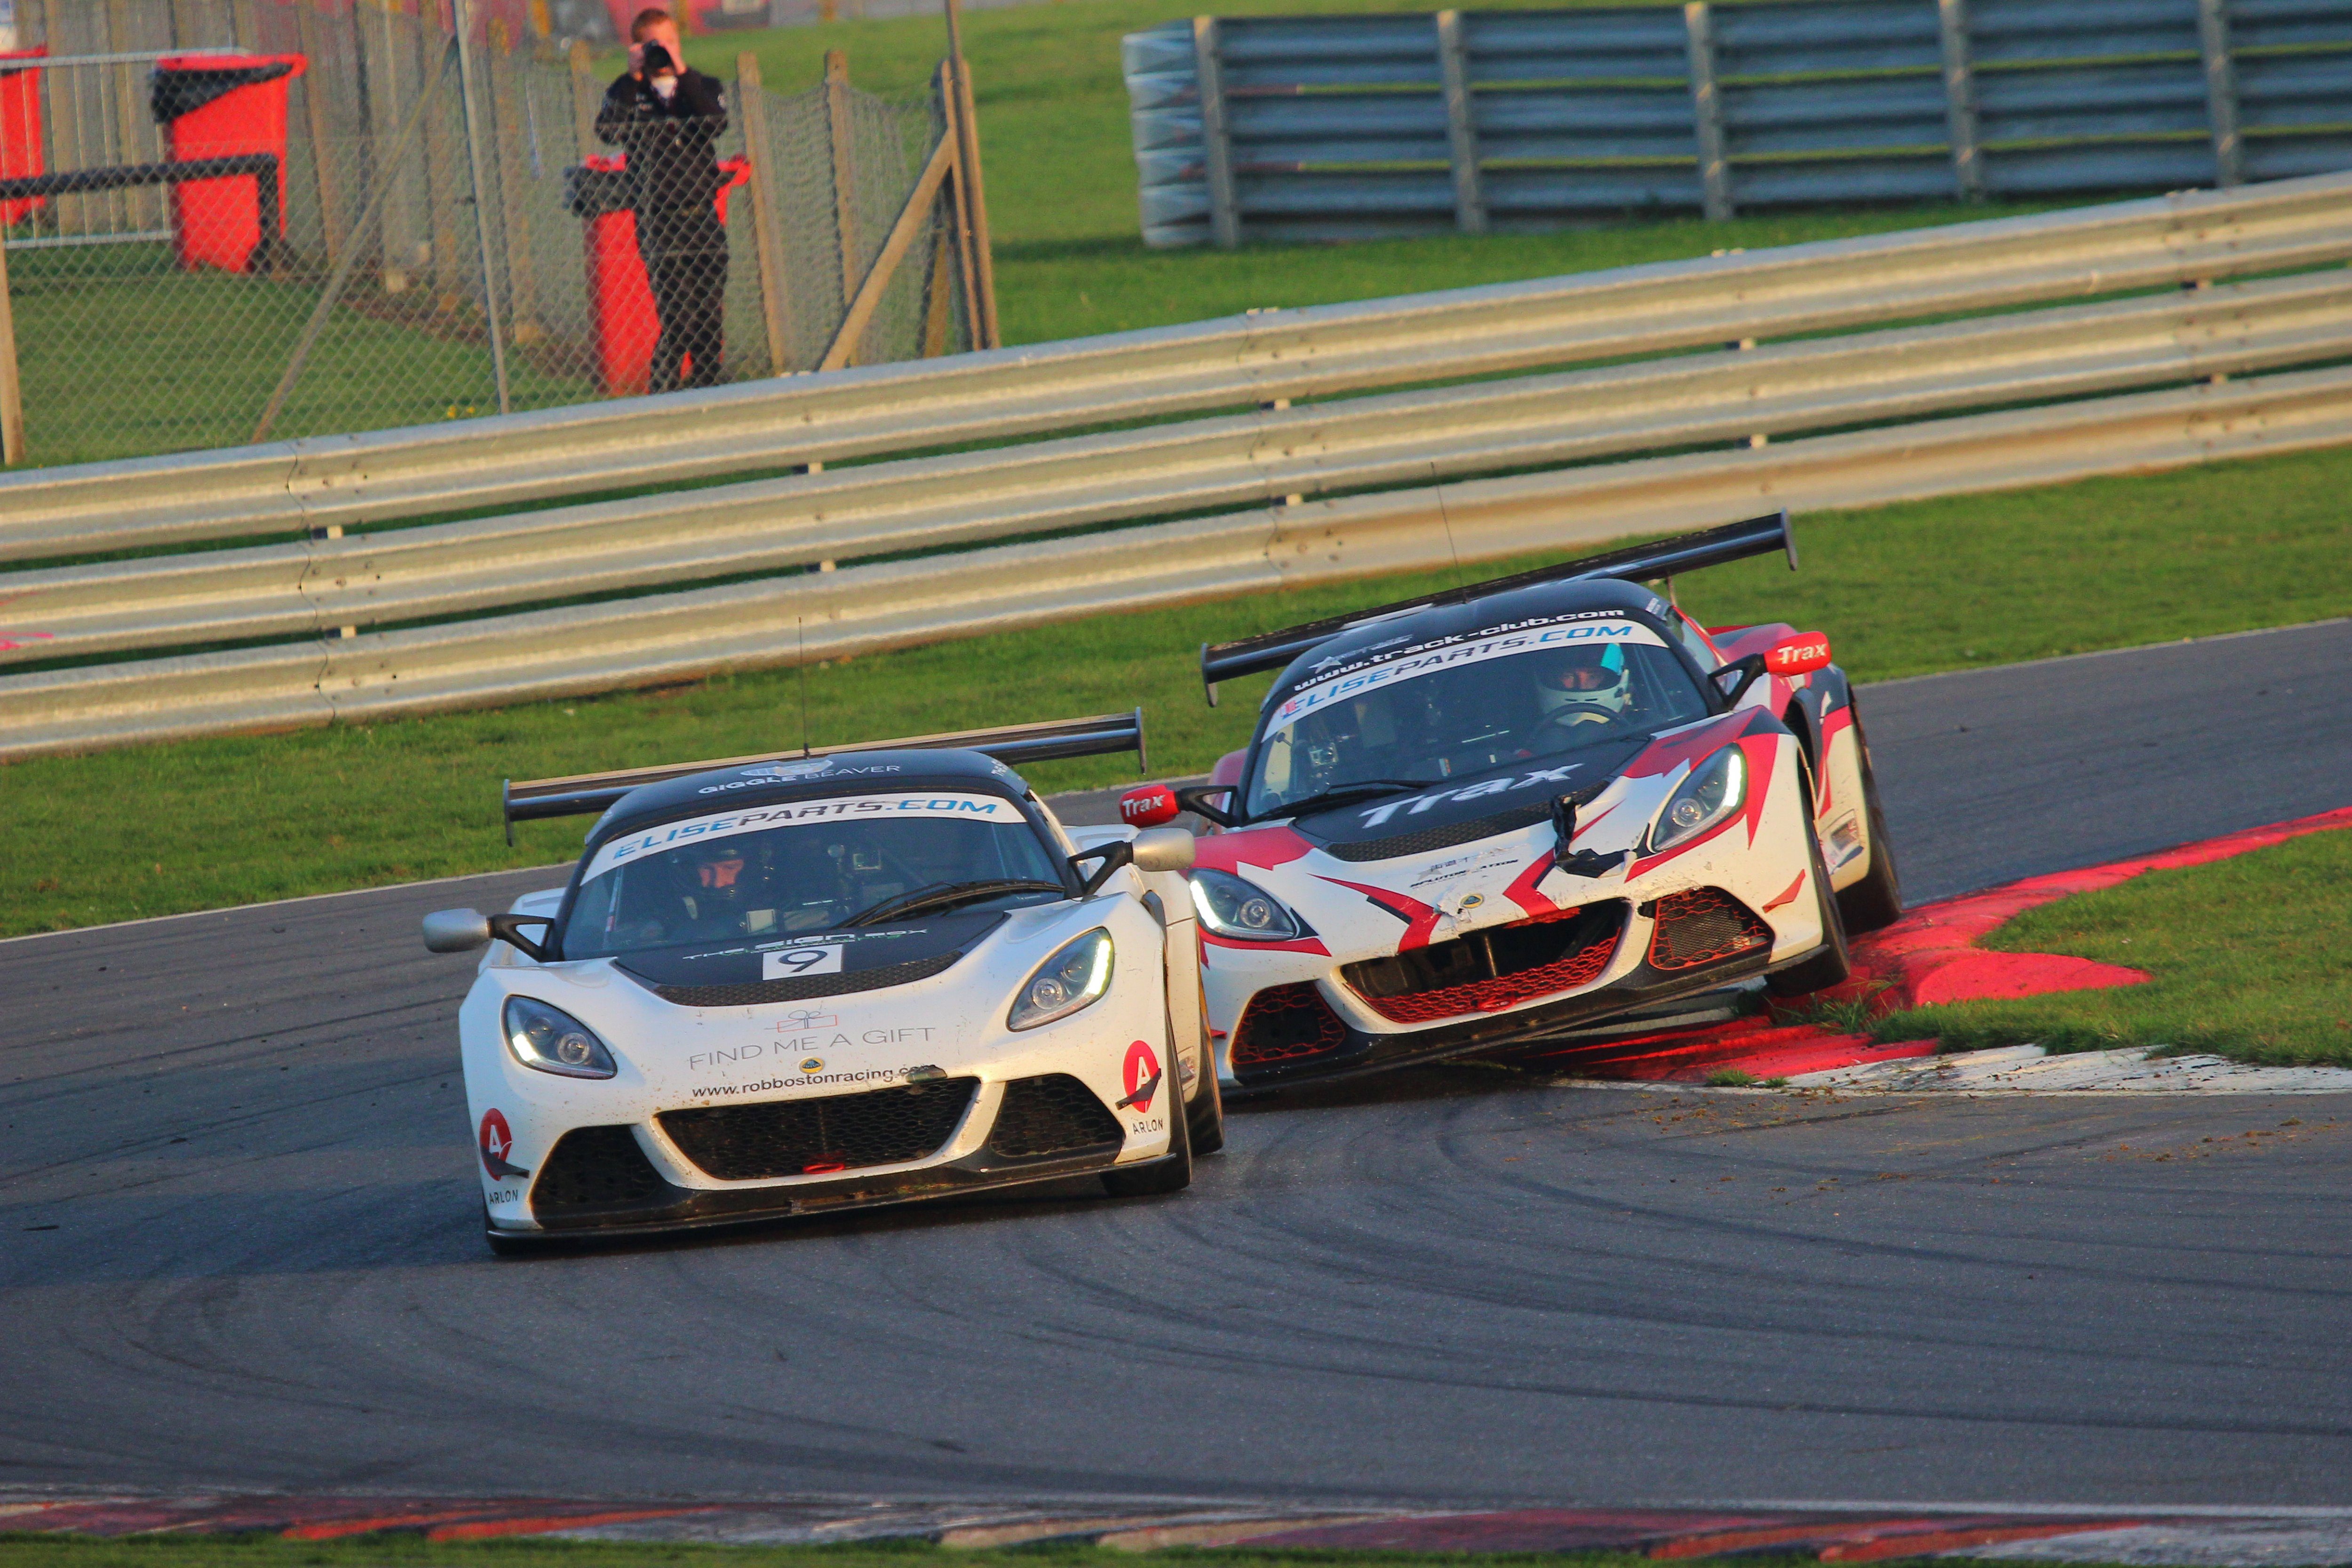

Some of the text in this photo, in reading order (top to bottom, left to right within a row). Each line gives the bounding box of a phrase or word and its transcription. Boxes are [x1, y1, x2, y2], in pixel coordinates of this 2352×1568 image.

[1777, 643, 1827, 665] Trax
[1282, 625, 1632, 720] ELISEPARTS.COM
[698, 765, 901, 794] GIGGLE BEAVER
[1122, 794, 1166, 817] Trax
[1359, 762, 1584, 829] Trax
[613, 799, 998, 859] ELISEPARTS.COM
[778, 950, 827, 973] 9
[689, 1027, 936, 1070] FIND ME A GIFT
[692, 1065, 934, 1097] www.robbostonracing.c
[1132, 1118, 1163, 1135] ARLON
[489, 1189, 518, 1205] ARLON
